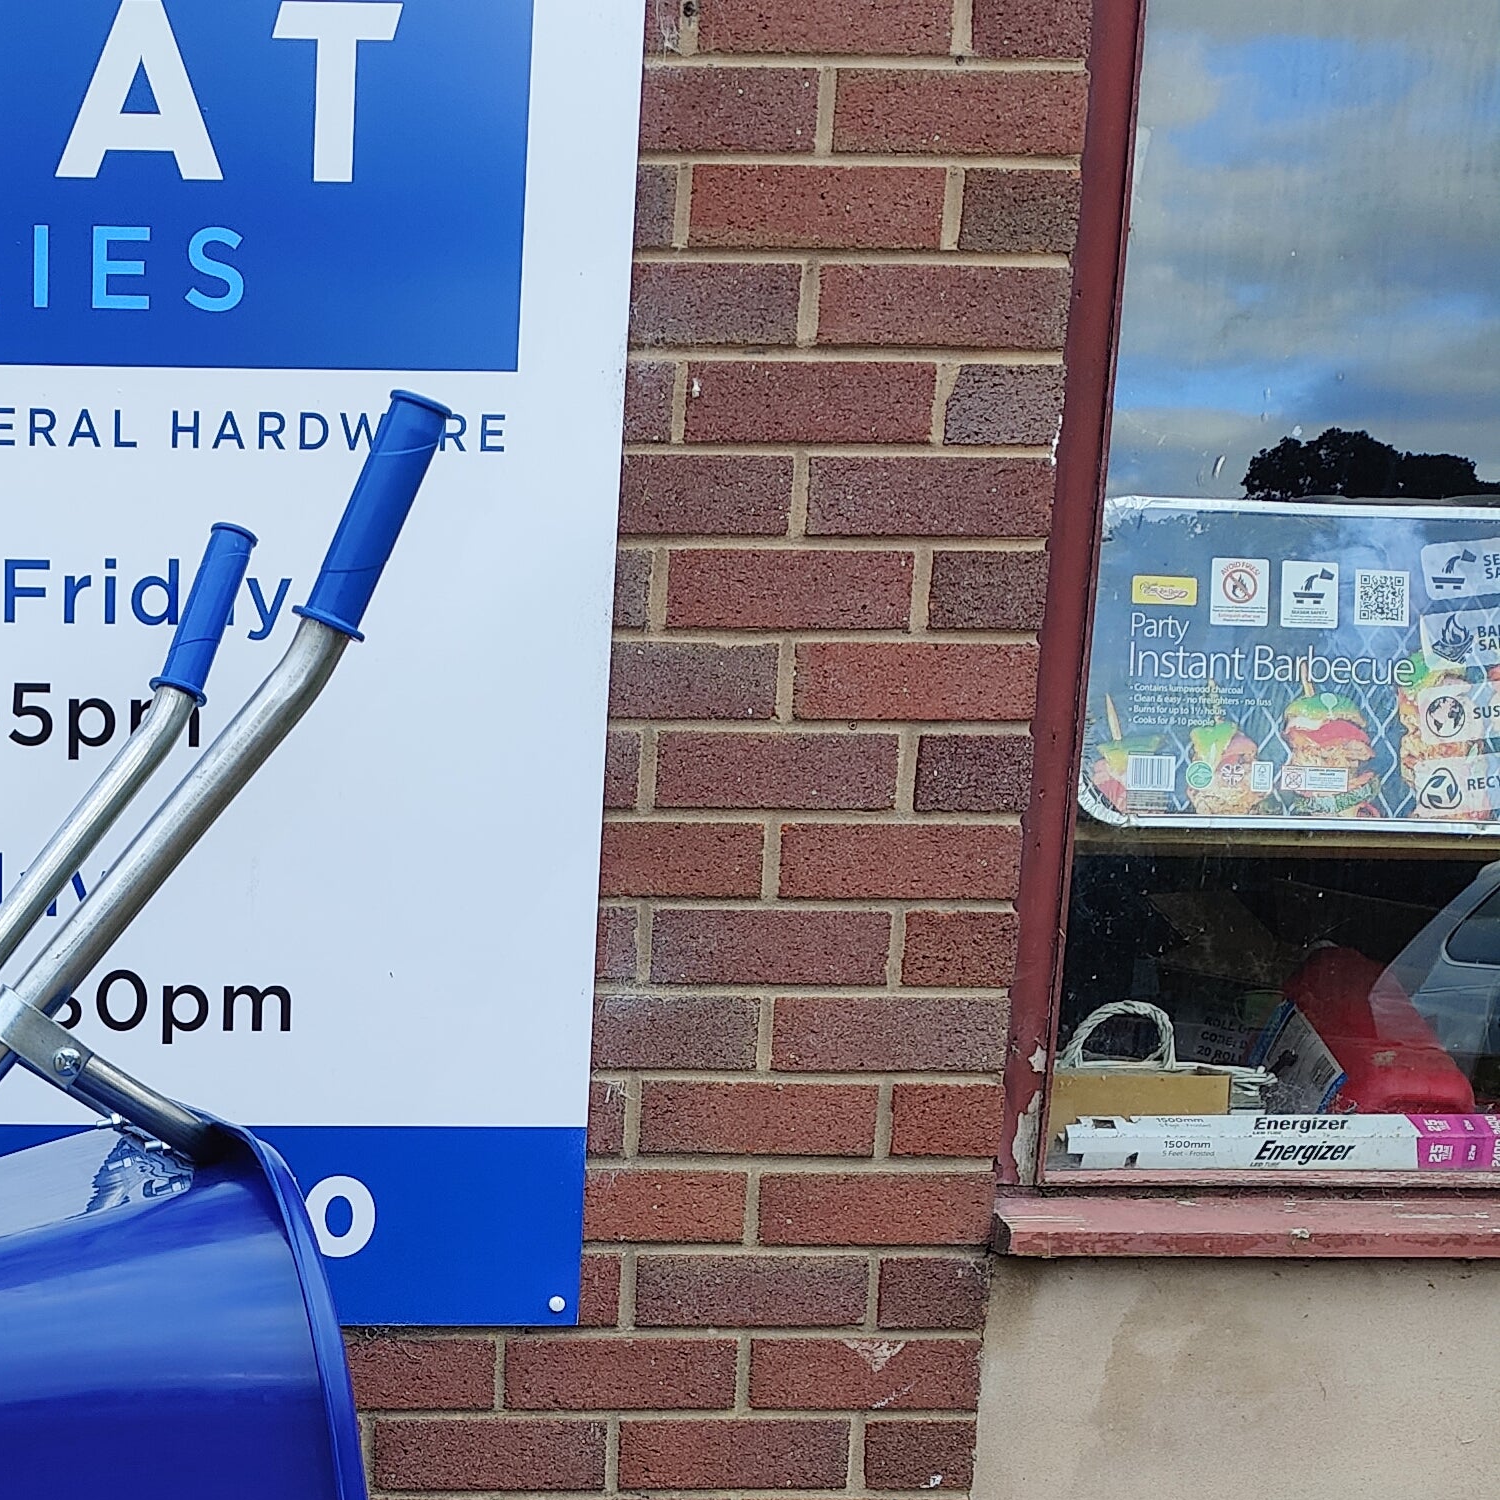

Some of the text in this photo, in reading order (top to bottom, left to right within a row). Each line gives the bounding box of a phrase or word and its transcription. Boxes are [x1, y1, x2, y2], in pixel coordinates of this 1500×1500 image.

[171, 410, 507, 453] HARDWRE
[3, 558, 293, 641] Fridy
[1130, 611, 1190, 645] Party
[1128, 640, 1415, 687] Instant Barbecue
[1133, 683, 1244, 695] Contains lumpwood charcoal
[1133, 693, 1157, 702] Clean
[1164, 696, 1181, 705] easy
[1133, 704, 1156, 714] Burns
[1156, 705, 1168, 714] for
[1168, 707, 1180, 716] up
[1180, 707, 1190, 715] to
[1204, 706, 1227, 716] hours
[1132, 715, 1156, 724] Cooks
[1156, 716, 1169, 724] for
[1187, 717, 1215, 727] people
[1253, 1116, 1349, 1134] Energizer
[1163, 1140, 1211, 1149] 1500mm
[1254, 1139, 1356, 1165] Energizer
